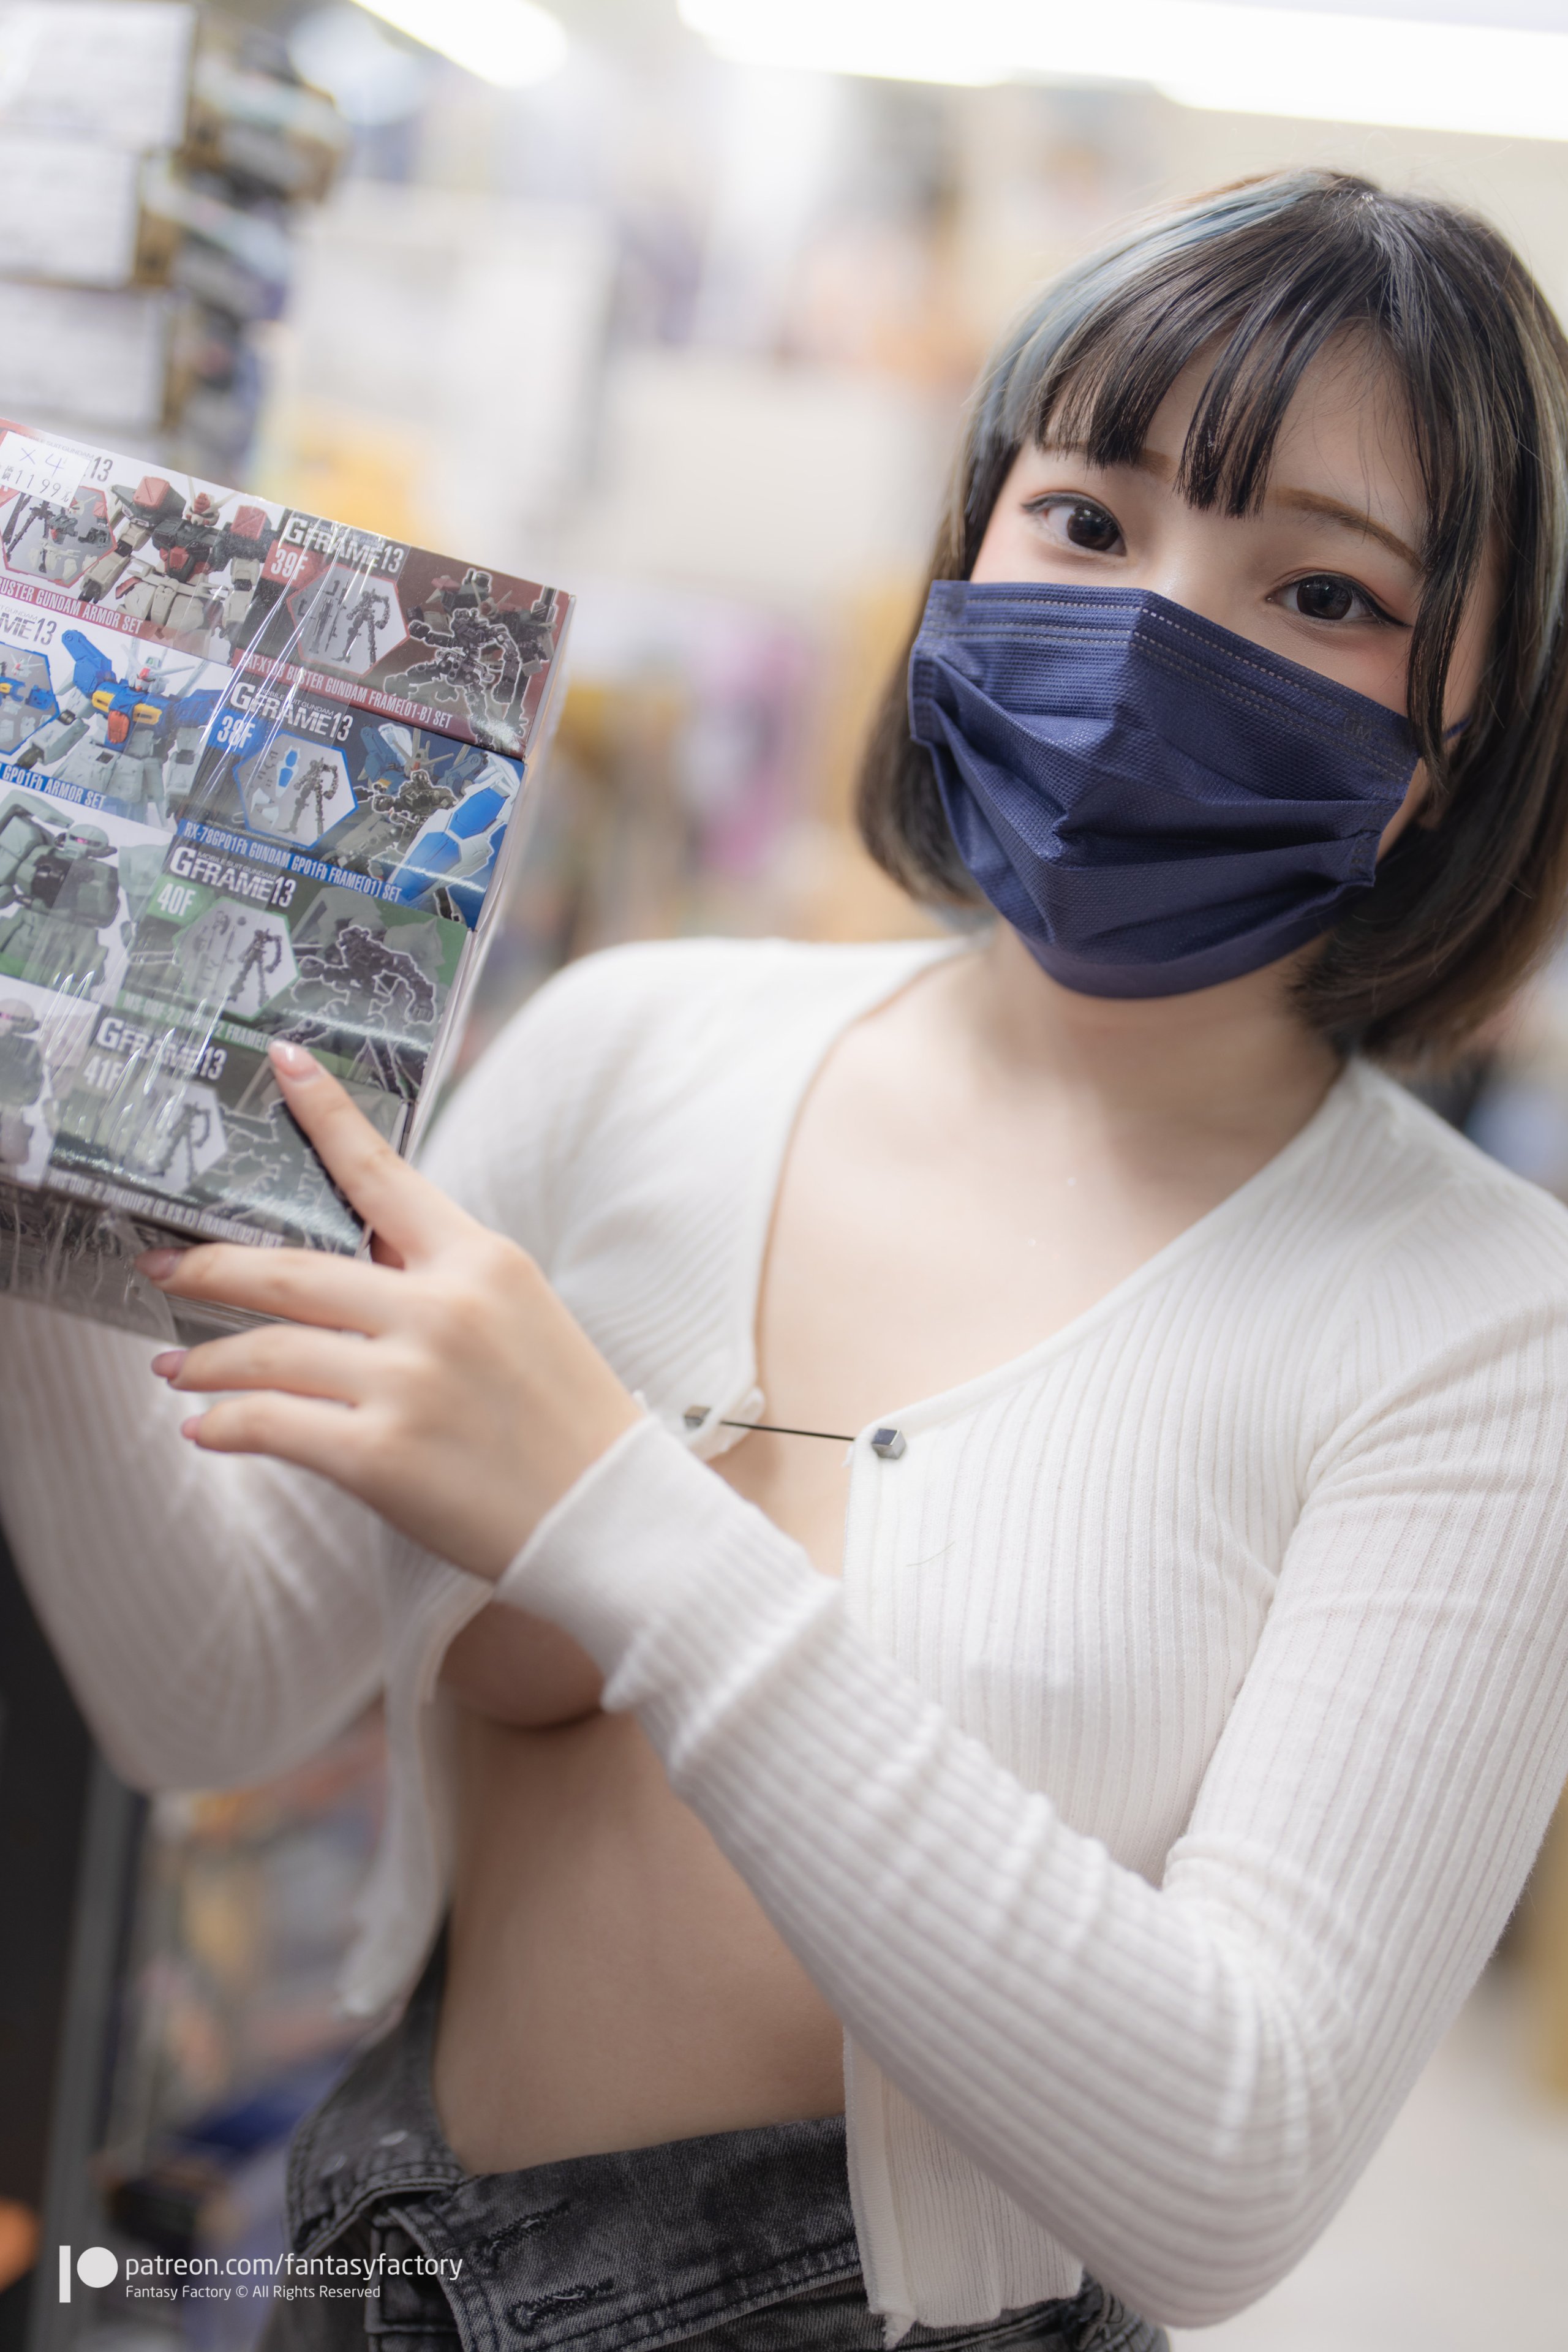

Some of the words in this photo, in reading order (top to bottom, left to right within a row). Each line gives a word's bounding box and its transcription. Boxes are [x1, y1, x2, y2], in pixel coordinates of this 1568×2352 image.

[271, 548, 308, 580] 39F
[36, 588, 82, 616] GUNDAM
[82, 602, 122, 628] ARMOR
[122, 616, 143, 635] SET
[286, 665, 325, 690] BUSTER
[325, 676, 368, 703] GUNDAM
[368, 690, 432, 723] FRAME[01-B]
[432, 710, 453, 729] SET
[287, 695, 302, 705] UIT
[301, 701, 335, 716] GUNDAM
[216, 715, 255, 748] 38F
[44, 778, 83, 804] ARMOR
[85, 790, 107, 810] SET
[184, 821, 249, 855] RX-78GP01Fb
[249, 843, 292, 869] GUNDAM
[291, 852, 328, 883] GP01Fb
[328, 868, 382, 898] FRAME[01]
[382, 884, 402, 903] SET
[197, 851, 226, 865] MOBILE
[226, 860, 244, 870] SUIT
[243, 865, 277, 880] GUNDAM
[157, 883, 197, 917] 40F
[84, 1055, 123, 1091] 41F
